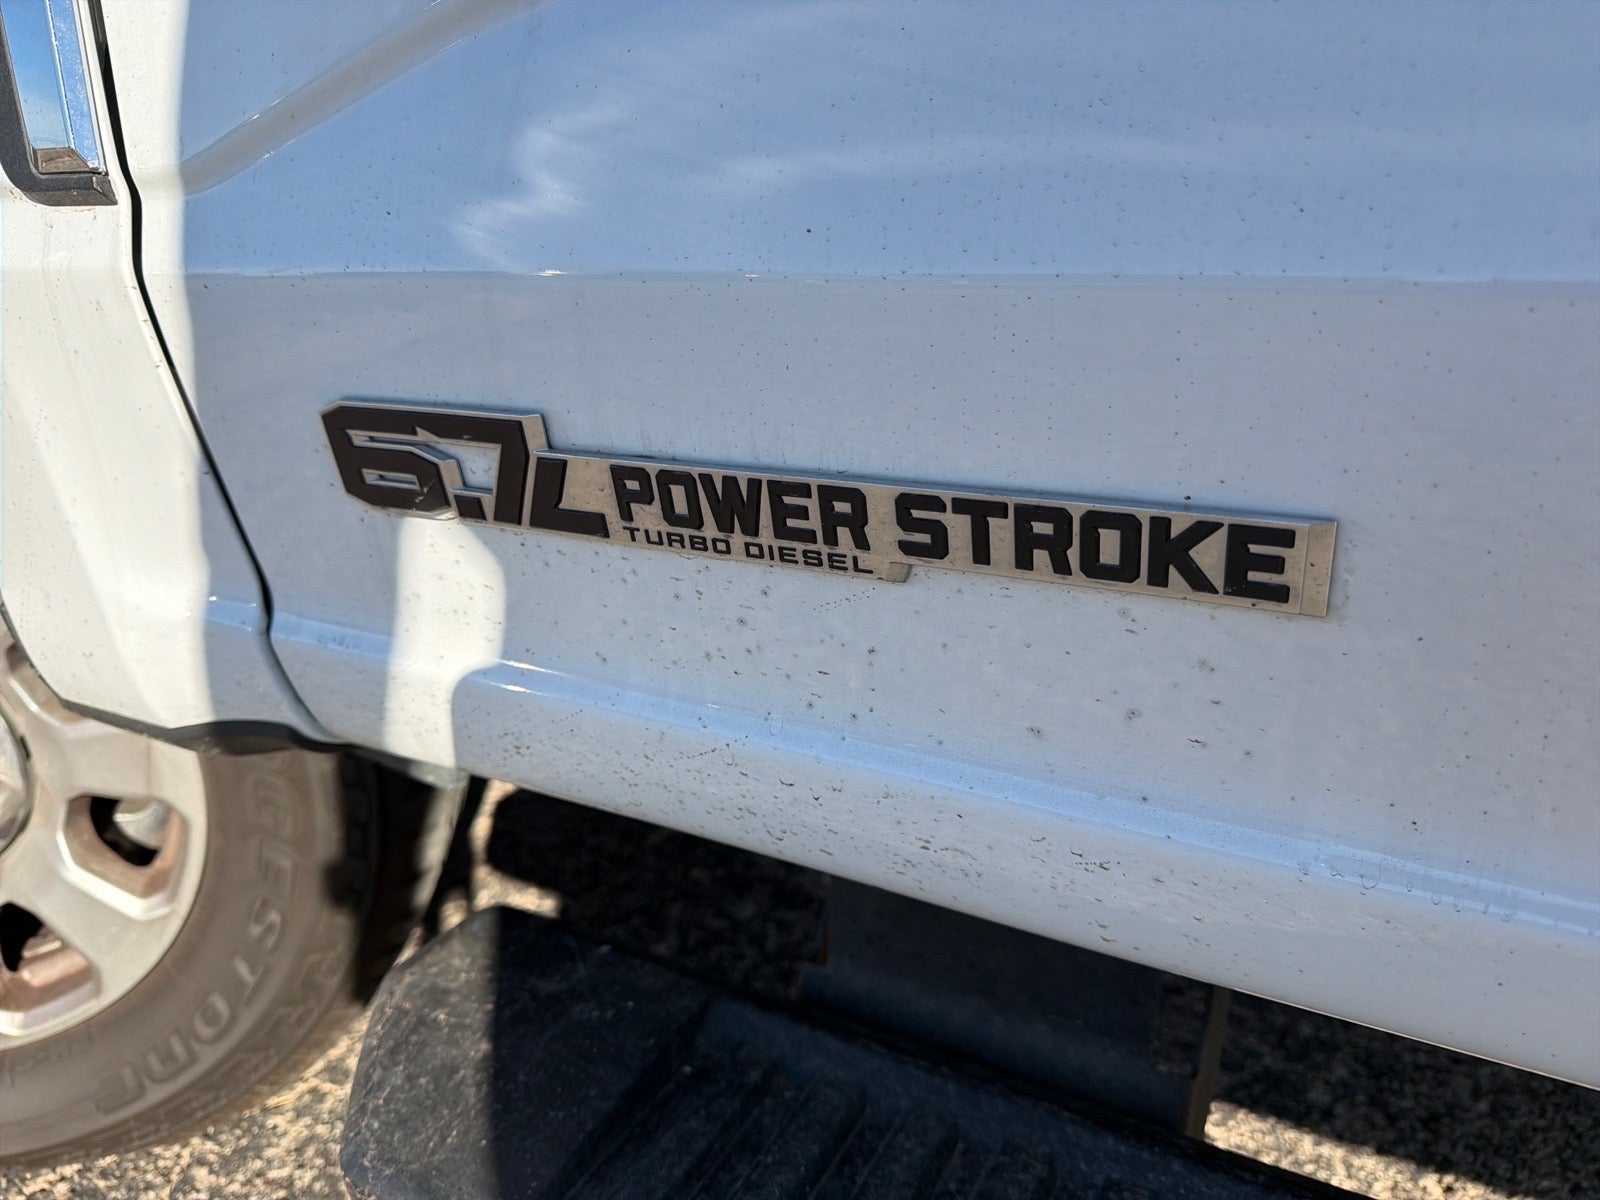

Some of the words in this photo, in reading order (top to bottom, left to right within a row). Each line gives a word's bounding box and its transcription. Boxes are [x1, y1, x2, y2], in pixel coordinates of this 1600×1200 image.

[321, 405, 611, 539] 6.7L
[610, 464, 871, 552] POWER
[895, 492, 1297, 604] STROKE
[623, 526, 732, 555] TURBO
[744, 541, 874, 575] DIESEL
